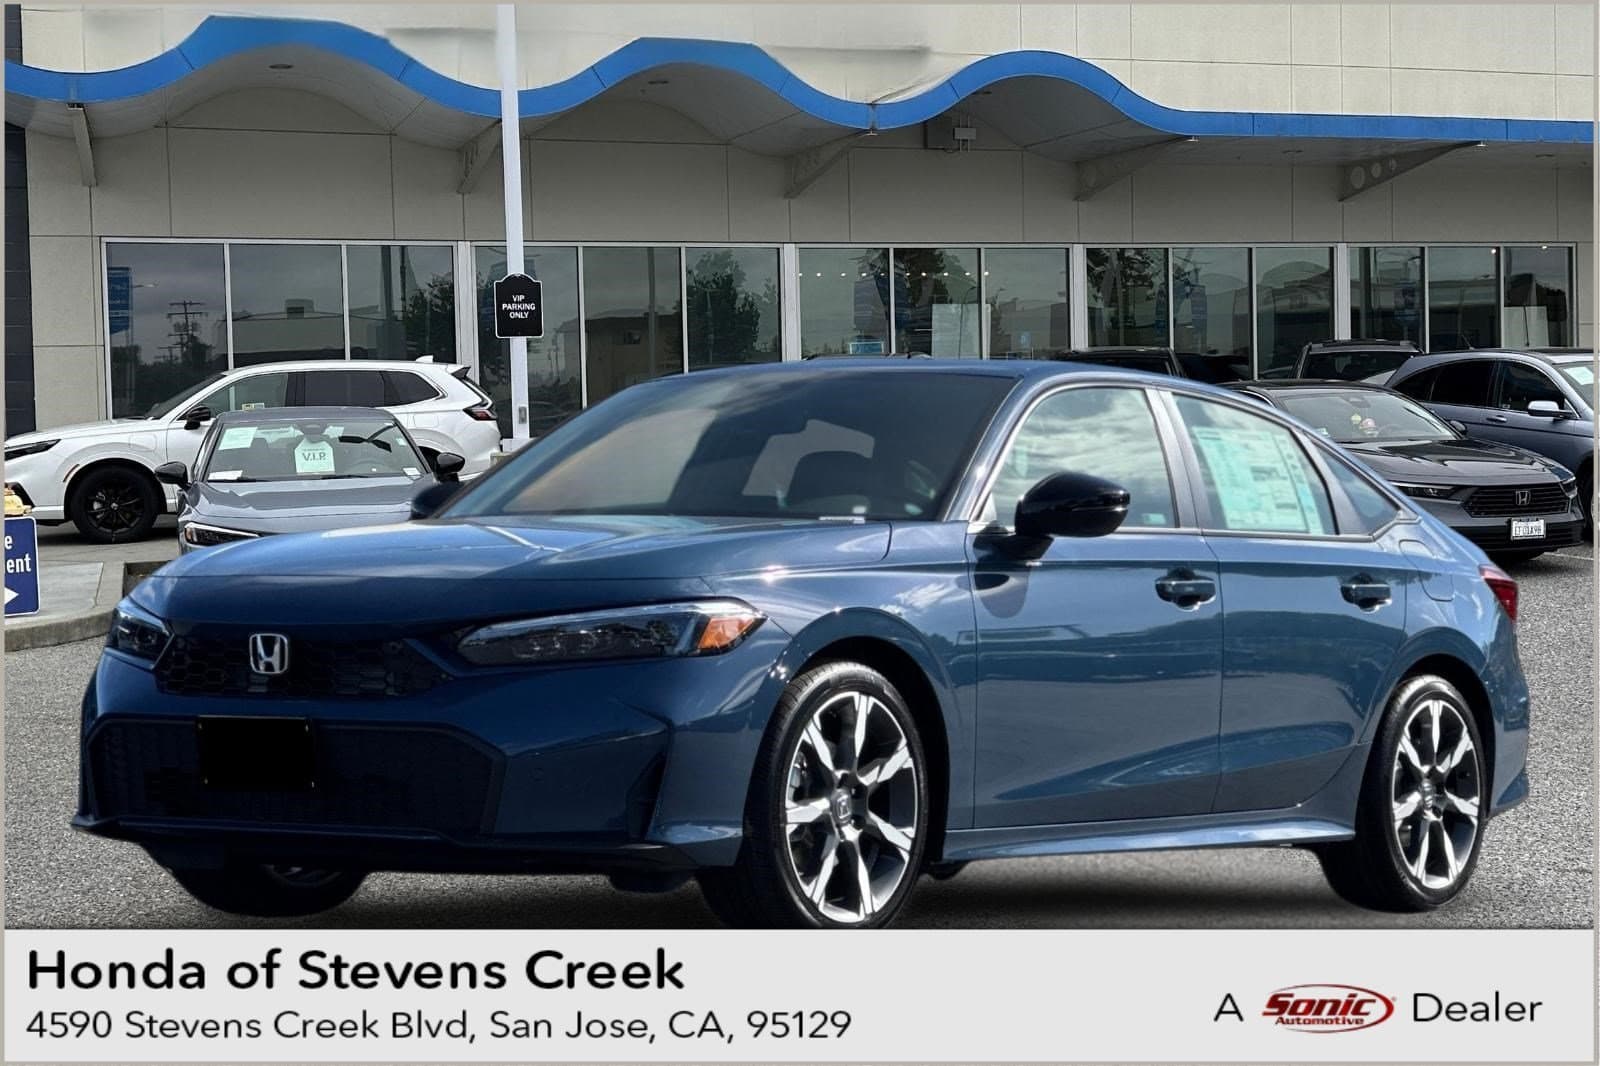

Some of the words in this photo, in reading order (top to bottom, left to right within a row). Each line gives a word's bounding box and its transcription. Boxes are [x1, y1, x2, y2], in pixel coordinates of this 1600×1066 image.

[512, 294, 525, 302] VIP
[502, 303, 536, 311] PARKING
[509, 311, 529, 319] ONLY
